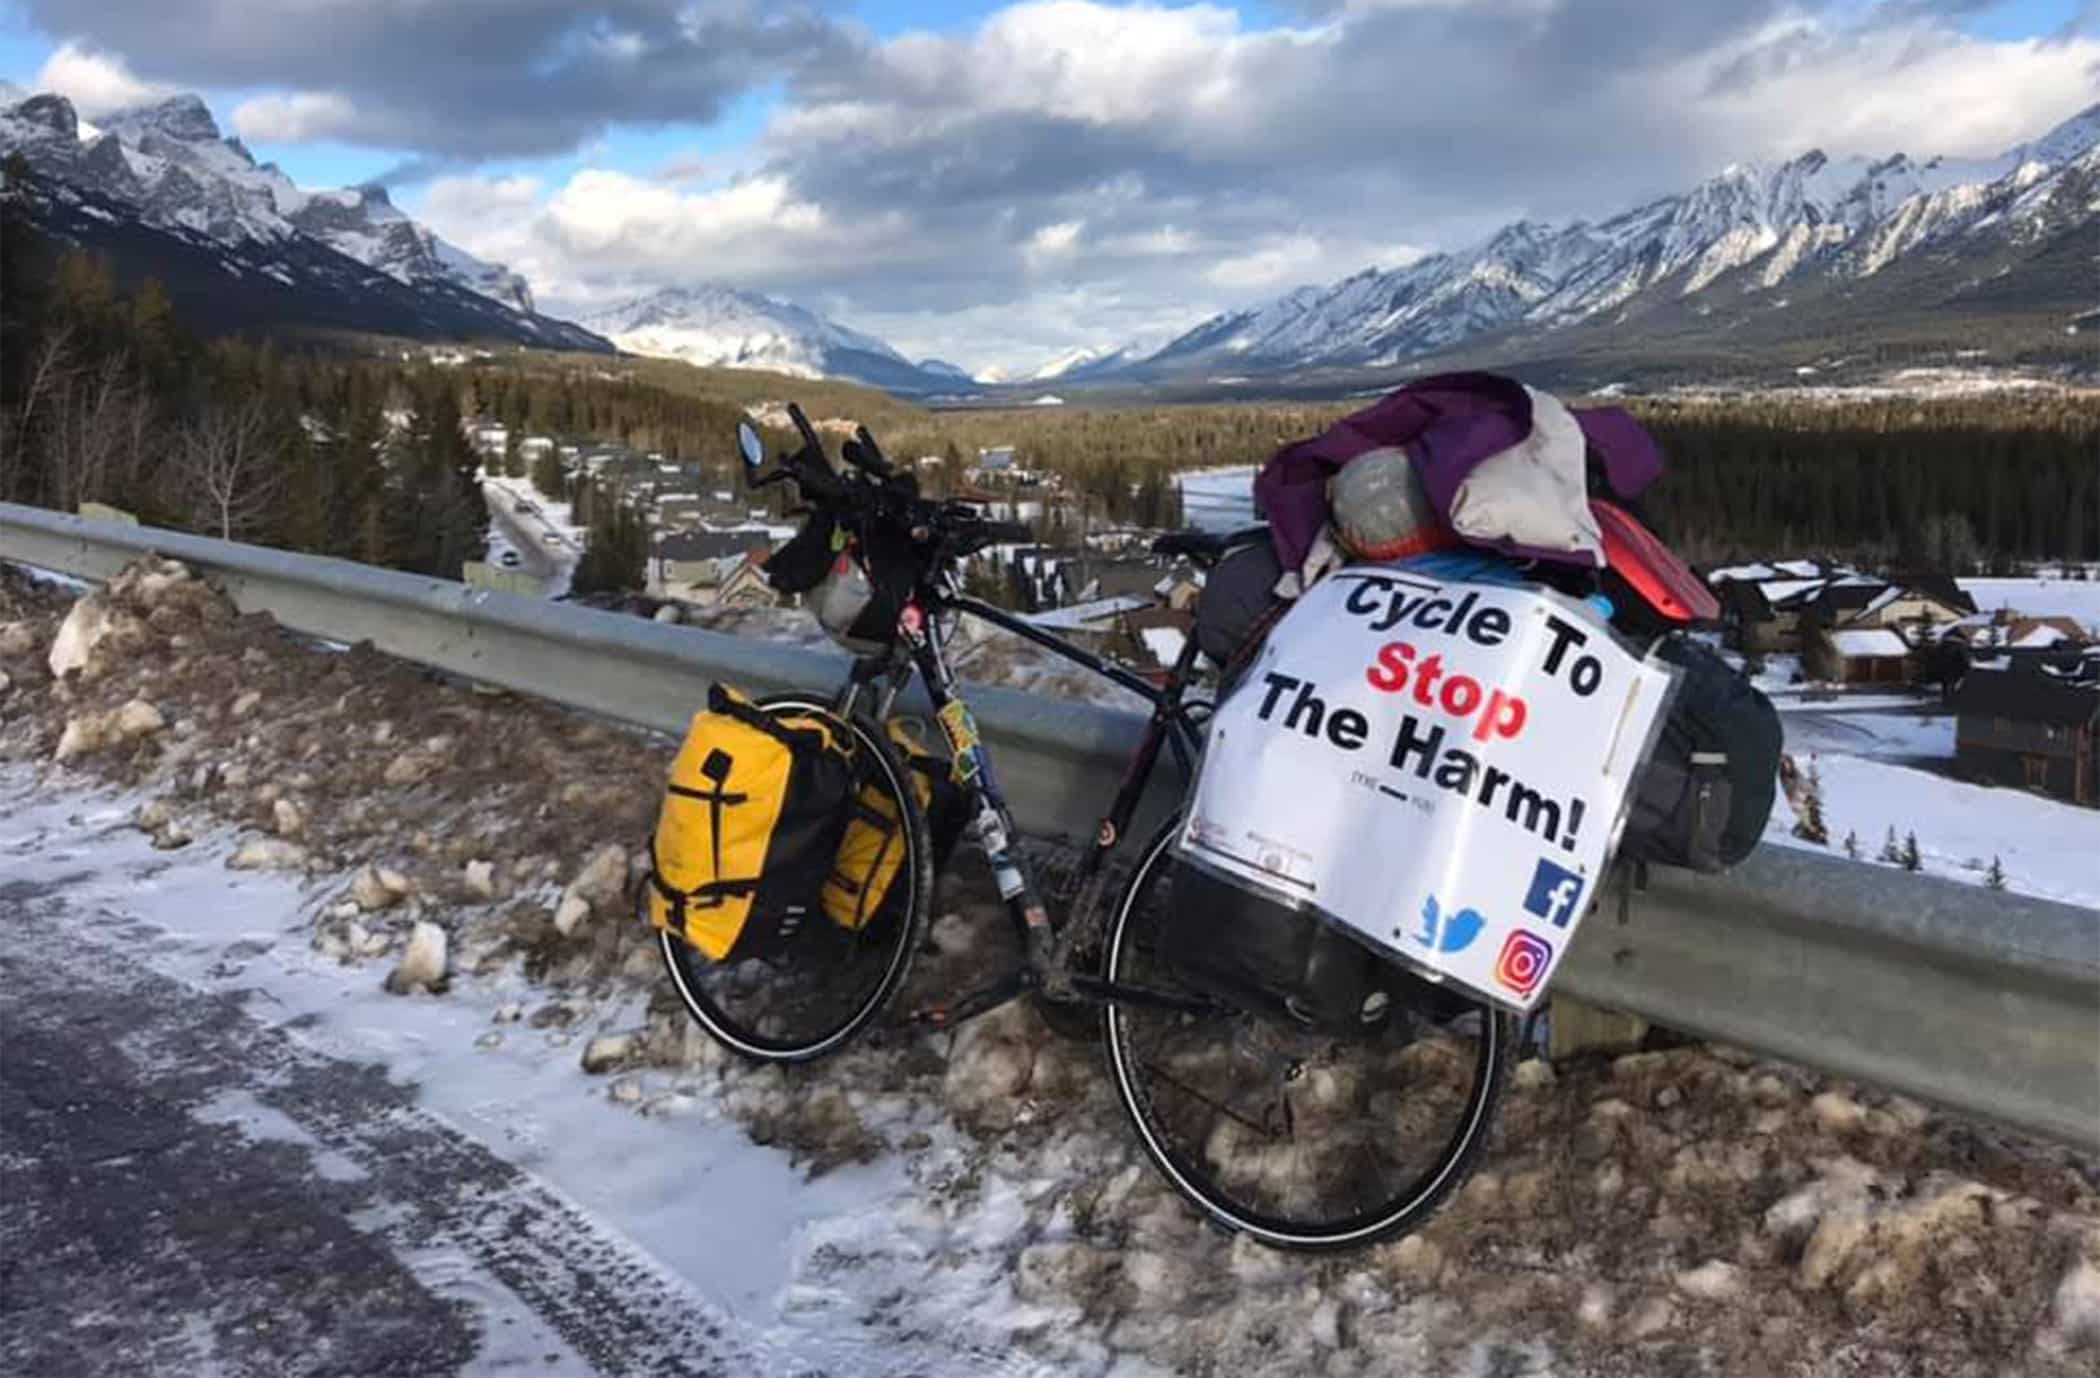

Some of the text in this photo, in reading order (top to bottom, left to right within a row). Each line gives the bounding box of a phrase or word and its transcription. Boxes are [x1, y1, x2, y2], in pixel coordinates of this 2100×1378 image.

[1345, 577, 1602, 697] Cycle To
[1366, 642, 1529, 743] Stop
[1257, 671, 1586, 852] The Harm!
